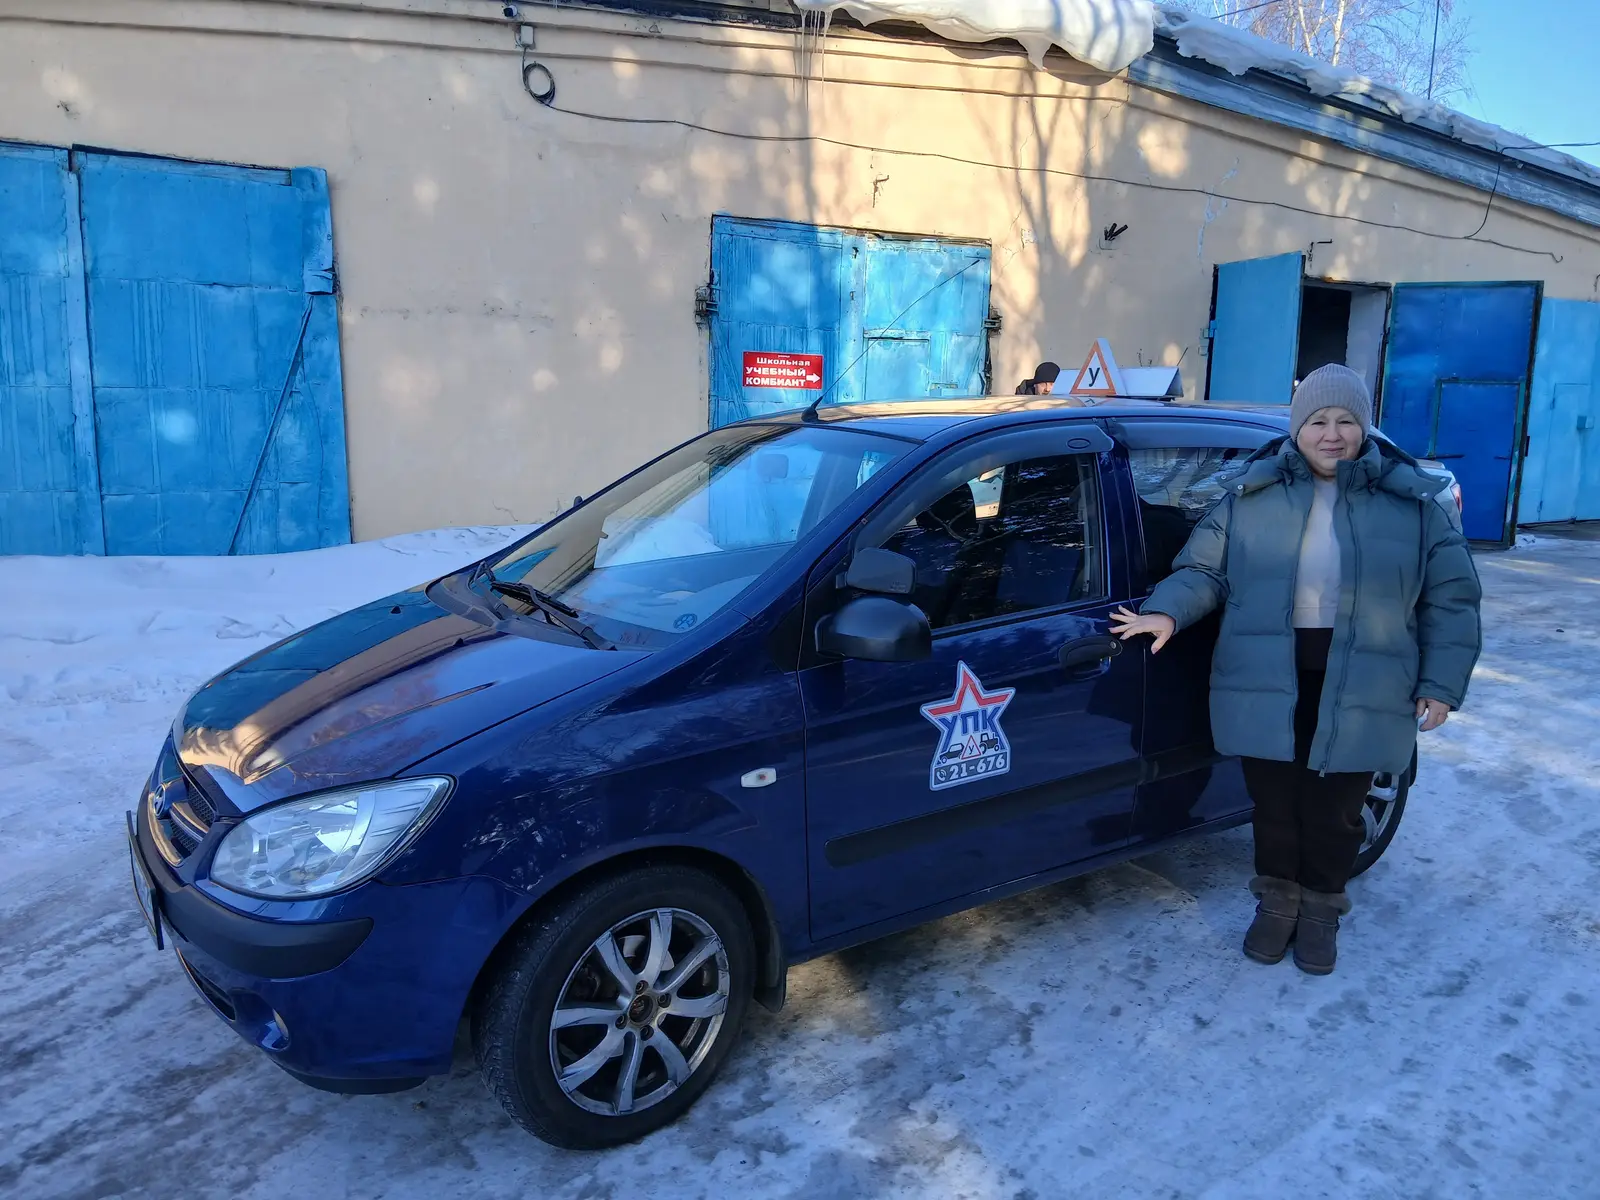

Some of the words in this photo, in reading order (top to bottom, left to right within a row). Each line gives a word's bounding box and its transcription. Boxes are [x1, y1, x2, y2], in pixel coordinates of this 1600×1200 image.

[745, 366, 806, 377] УЧЕБНЫЙ
[756, 357, 811, 367] Школьная
[1088, 367, 1101, 387] У
[938, 706, 1006, 753] УПК
[949, 755, 1006, 780] 21-676
